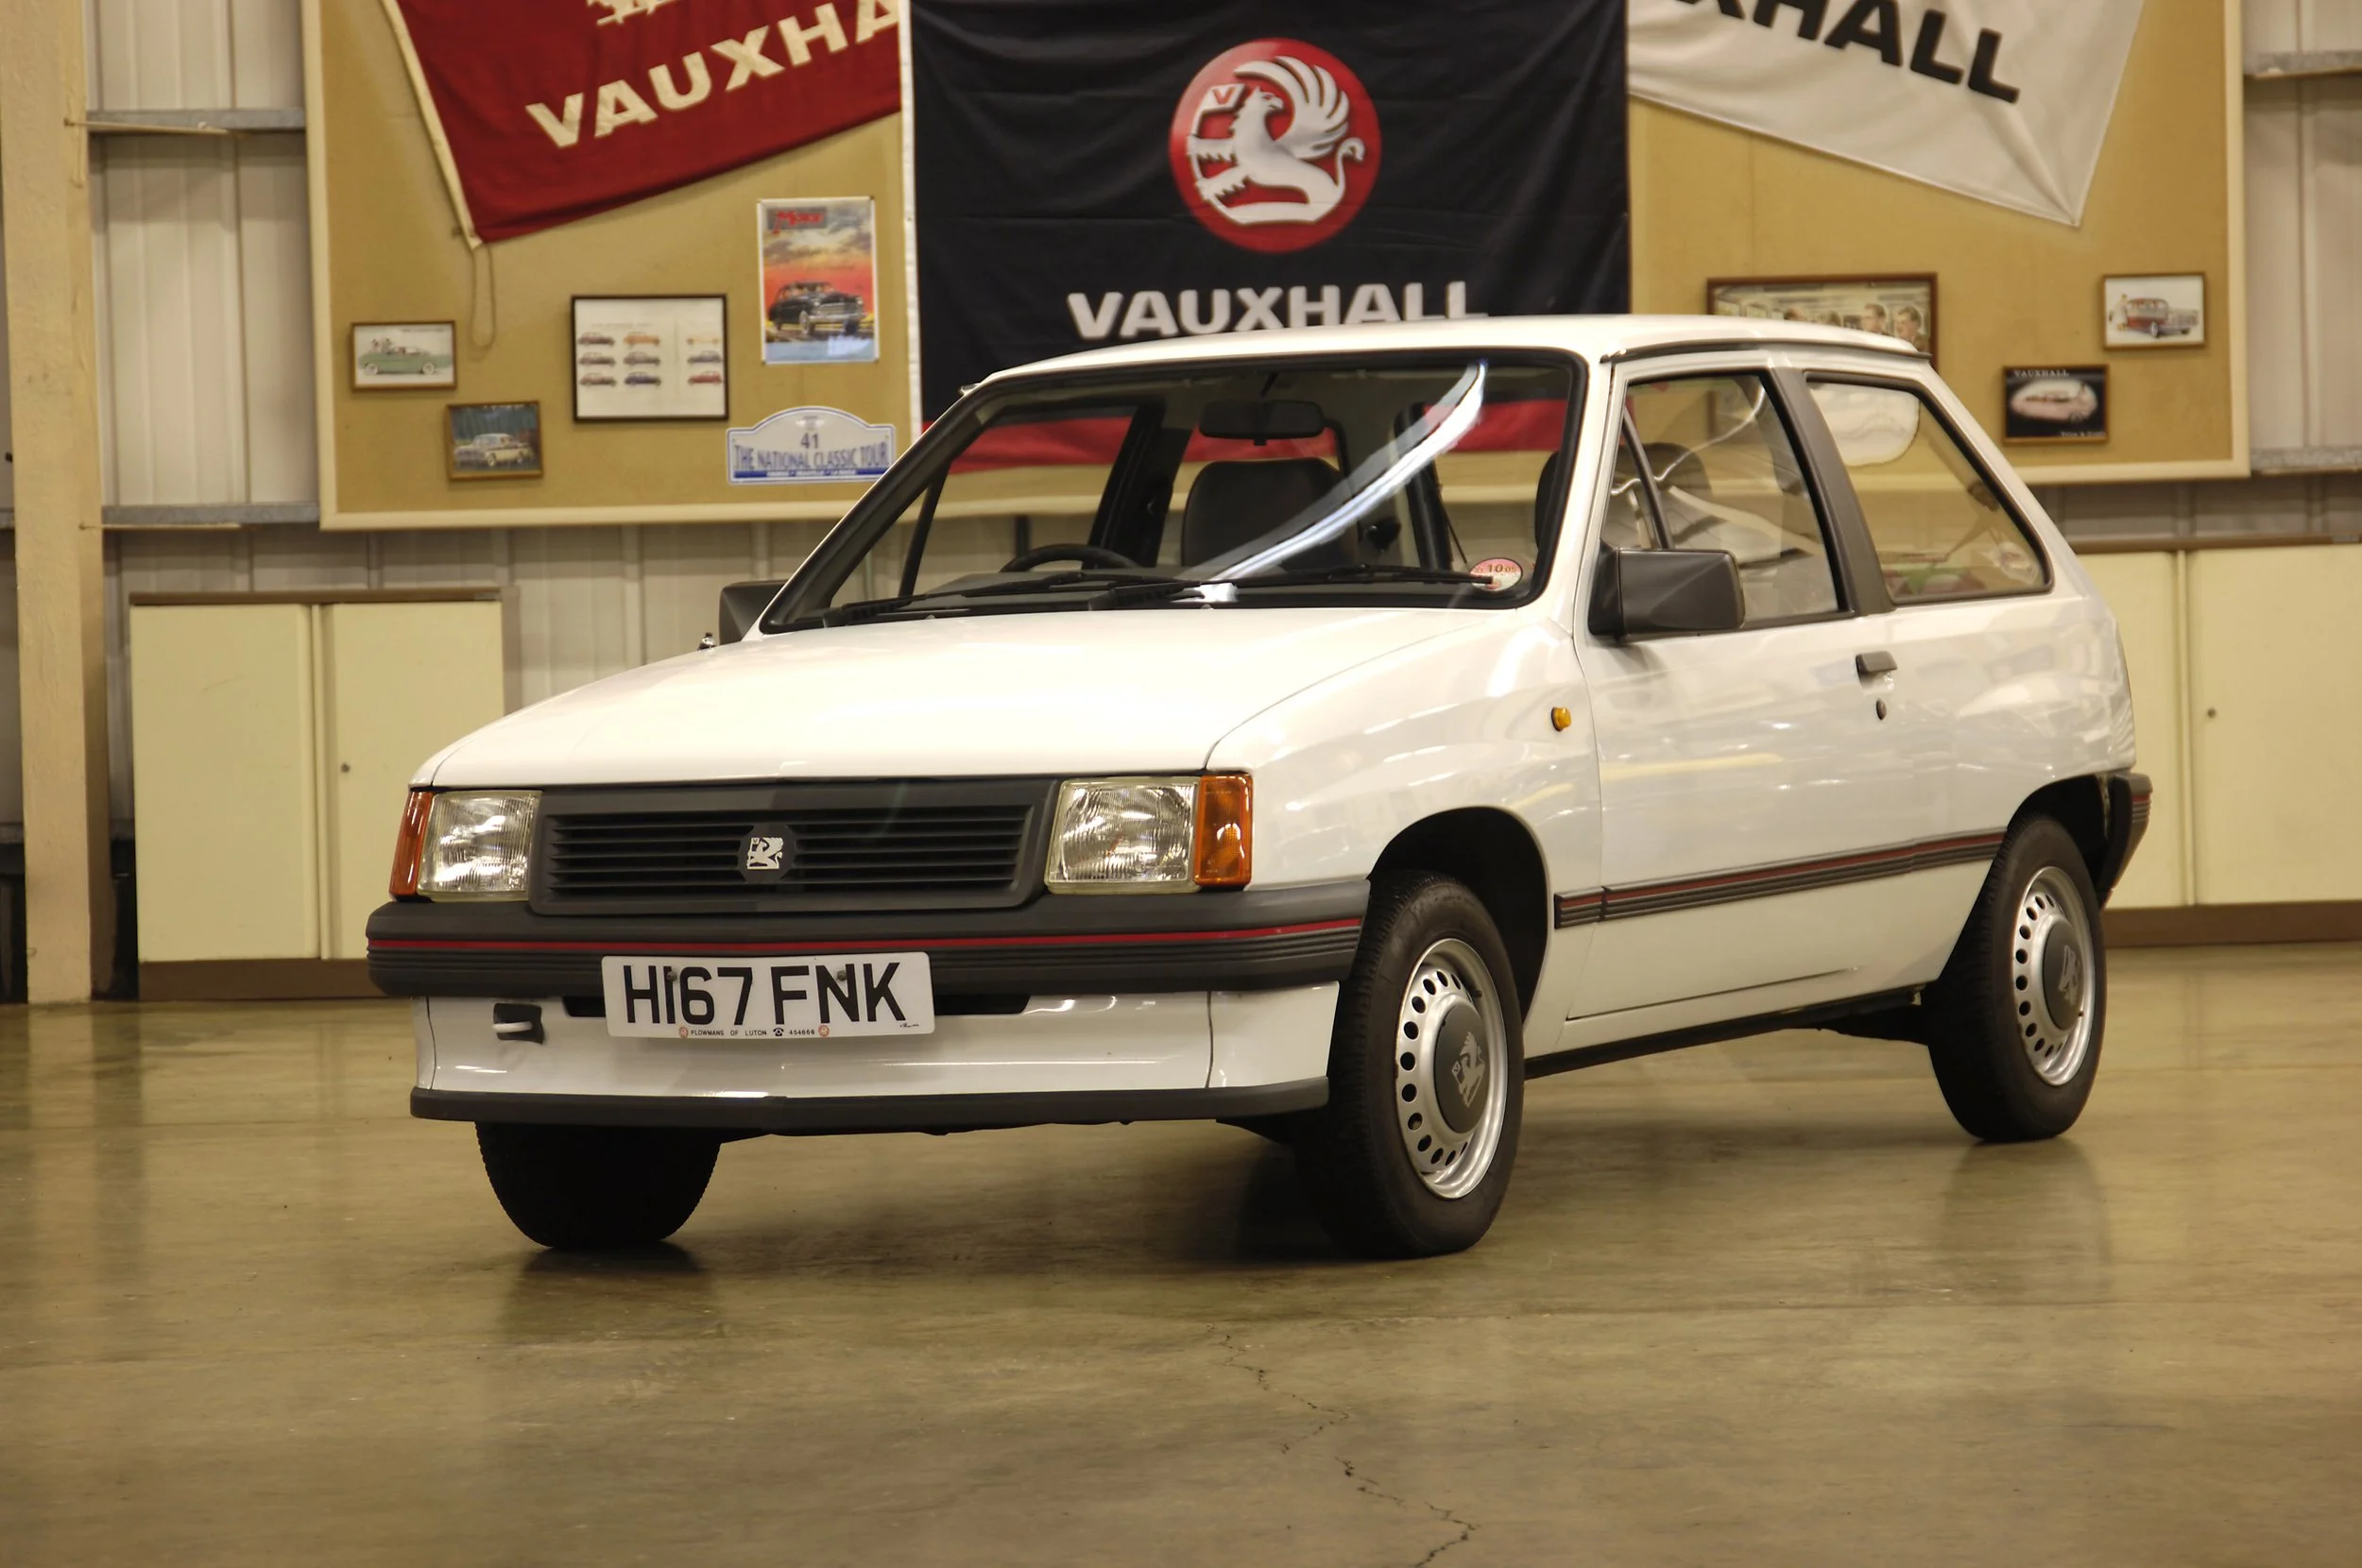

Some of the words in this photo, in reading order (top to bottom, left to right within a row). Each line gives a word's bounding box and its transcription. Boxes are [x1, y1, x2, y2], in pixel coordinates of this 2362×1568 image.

[1067, 281, 1489, 340] VAUXHALL
[2014, 369, 2070, 378] VAUXHALL
[800, 433, 819, 449] 41
[735, 445, 755, 469] THE
[758, 451, 811, 469] NATIONAL
[813, 448, 858, 469] CLASSIC
[861, 441, 889, 468] TOUR
[1488, 564, 1503, 572] 10
[623, 964, 753, 1026] H167
[770, 962, 907, 1026] FNK
